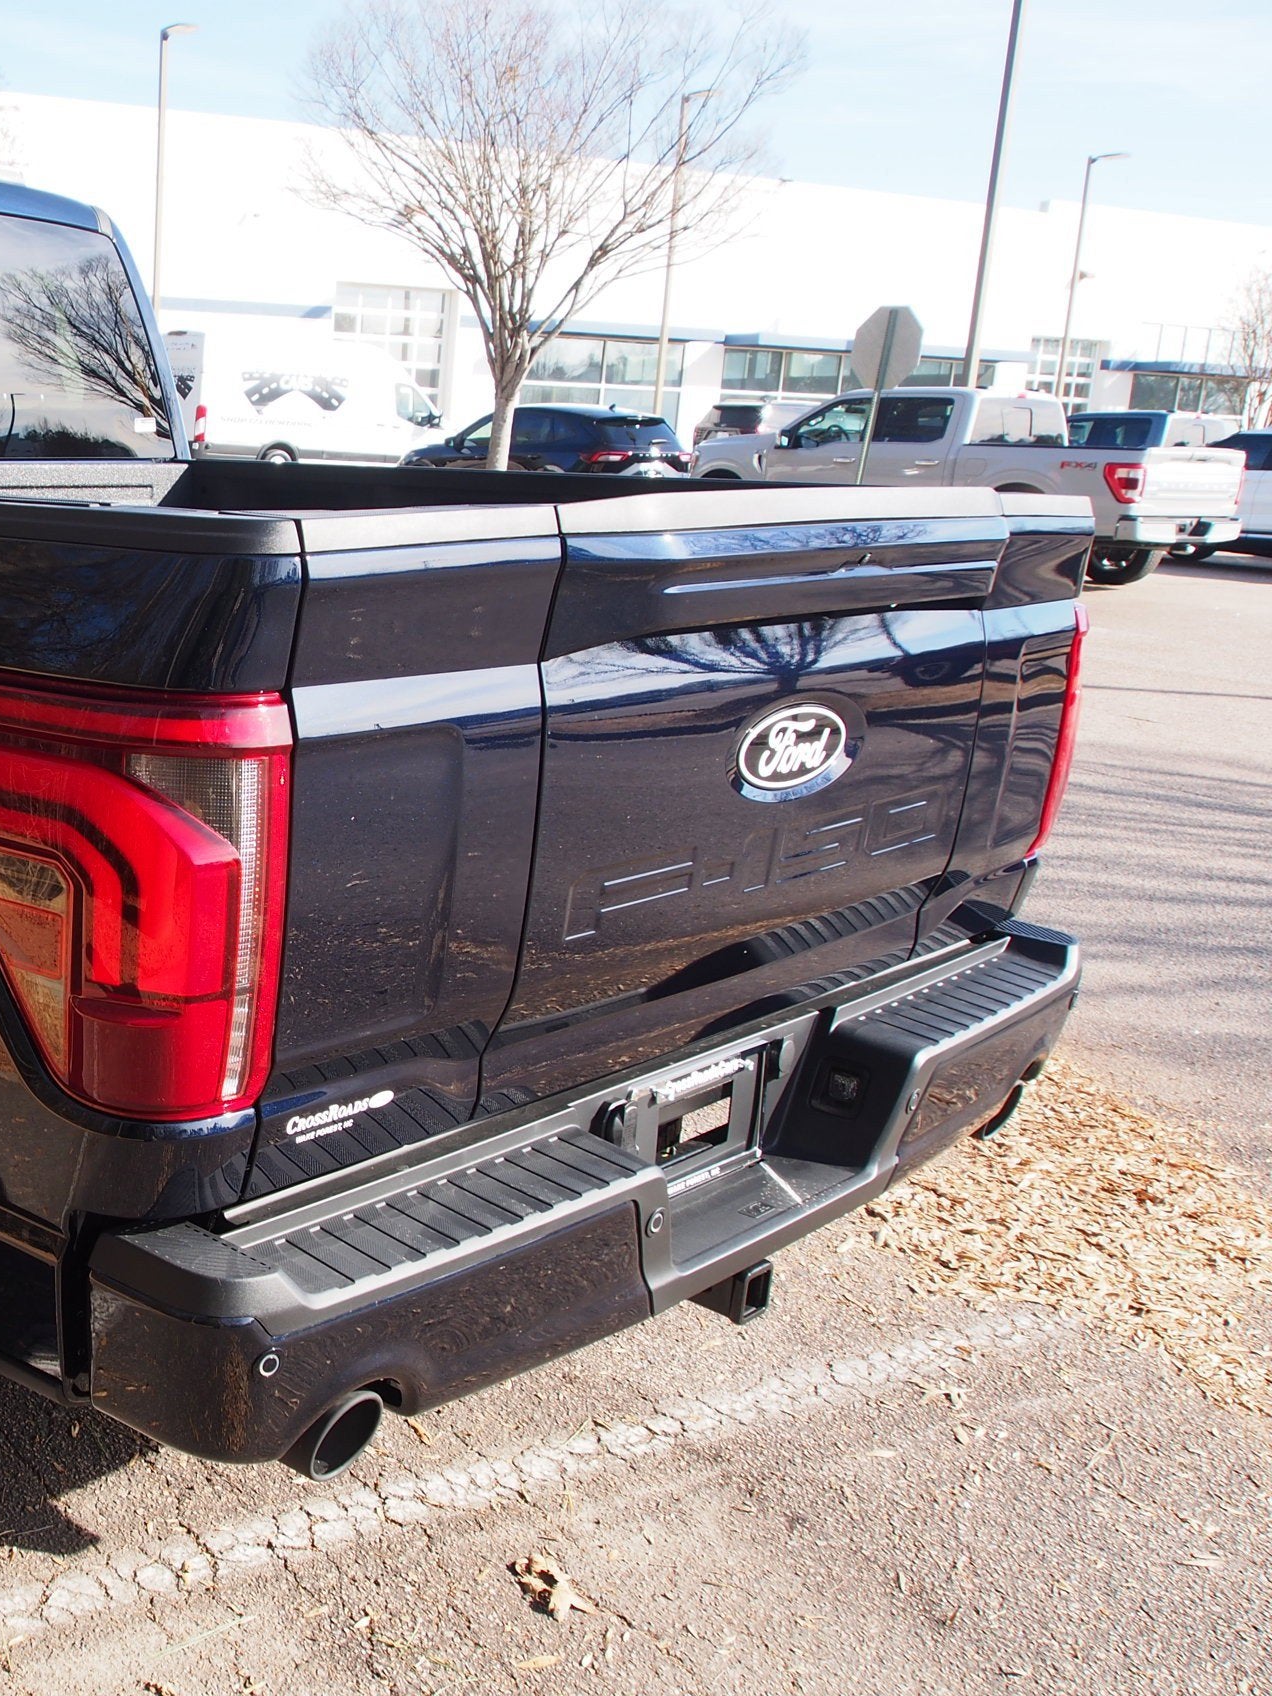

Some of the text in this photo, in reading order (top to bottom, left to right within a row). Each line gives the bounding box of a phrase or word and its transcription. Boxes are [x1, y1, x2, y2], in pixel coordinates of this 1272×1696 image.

[1059, 460, 1098, 471] FX4
[758, 718, 831, 778] Ford
[563, 785, 948, 942] F-150
